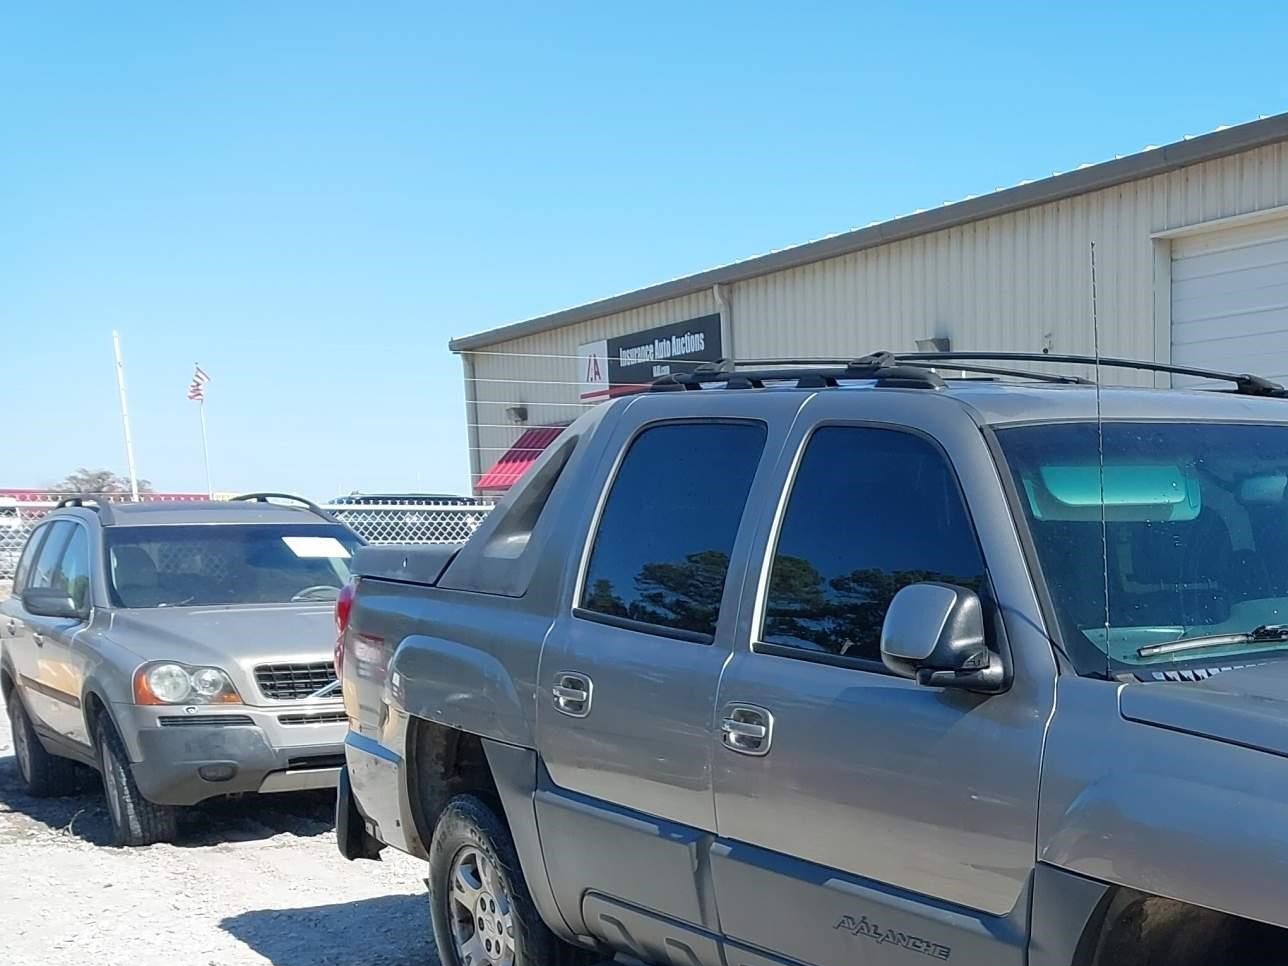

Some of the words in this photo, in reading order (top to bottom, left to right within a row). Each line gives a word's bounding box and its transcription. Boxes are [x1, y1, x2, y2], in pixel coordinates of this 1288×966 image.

[620, 344, 654, 367] Insurance
[654, 338, 671, 360] Auto
[671, 332, 705, 357] Auctions
[833, 914, 952, 961] AVALANCHE
